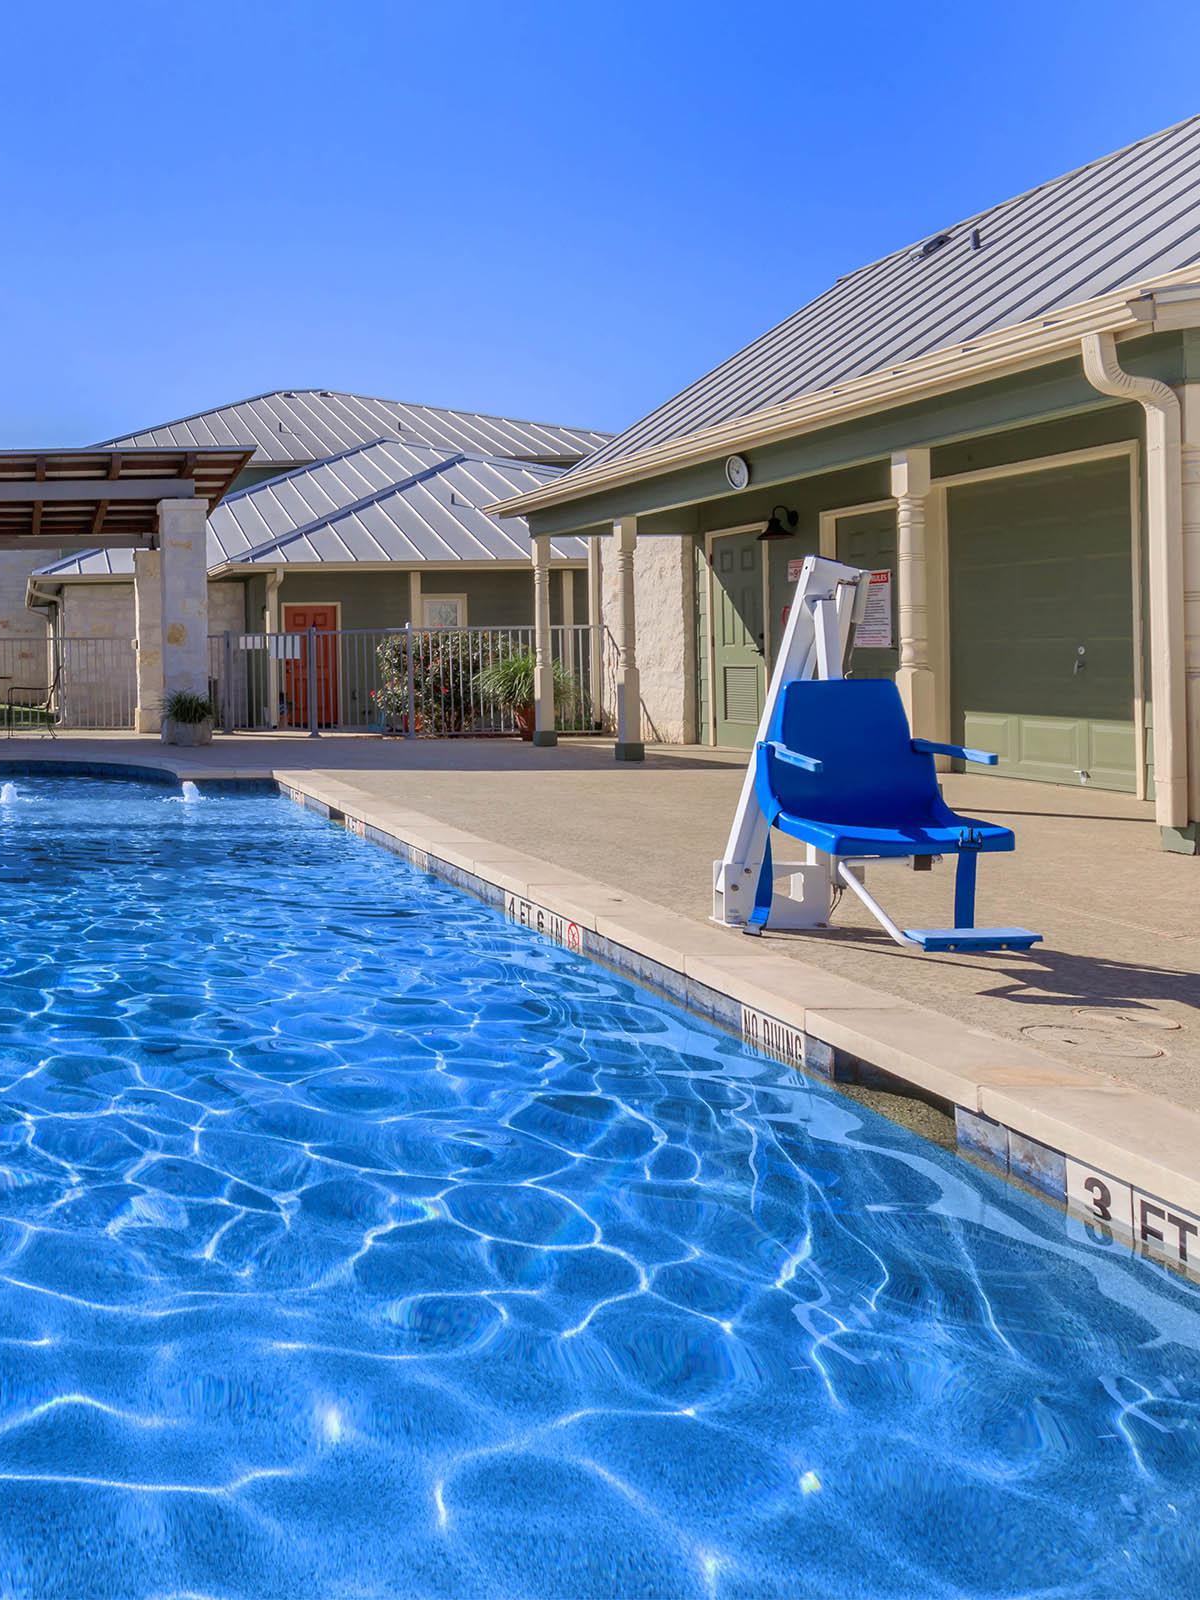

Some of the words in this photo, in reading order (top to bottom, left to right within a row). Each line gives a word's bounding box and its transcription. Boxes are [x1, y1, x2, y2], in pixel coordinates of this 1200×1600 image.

[520, 901, 532, 926] FT
[550, 915, 563, 940] IN
[744, 1009, 758, 1038] NO
[763, 1019, 802, 1060] DIVING
[1084, 1177, 1112, 1221] 3
[1140, 1199, 1198, 1262] FT
